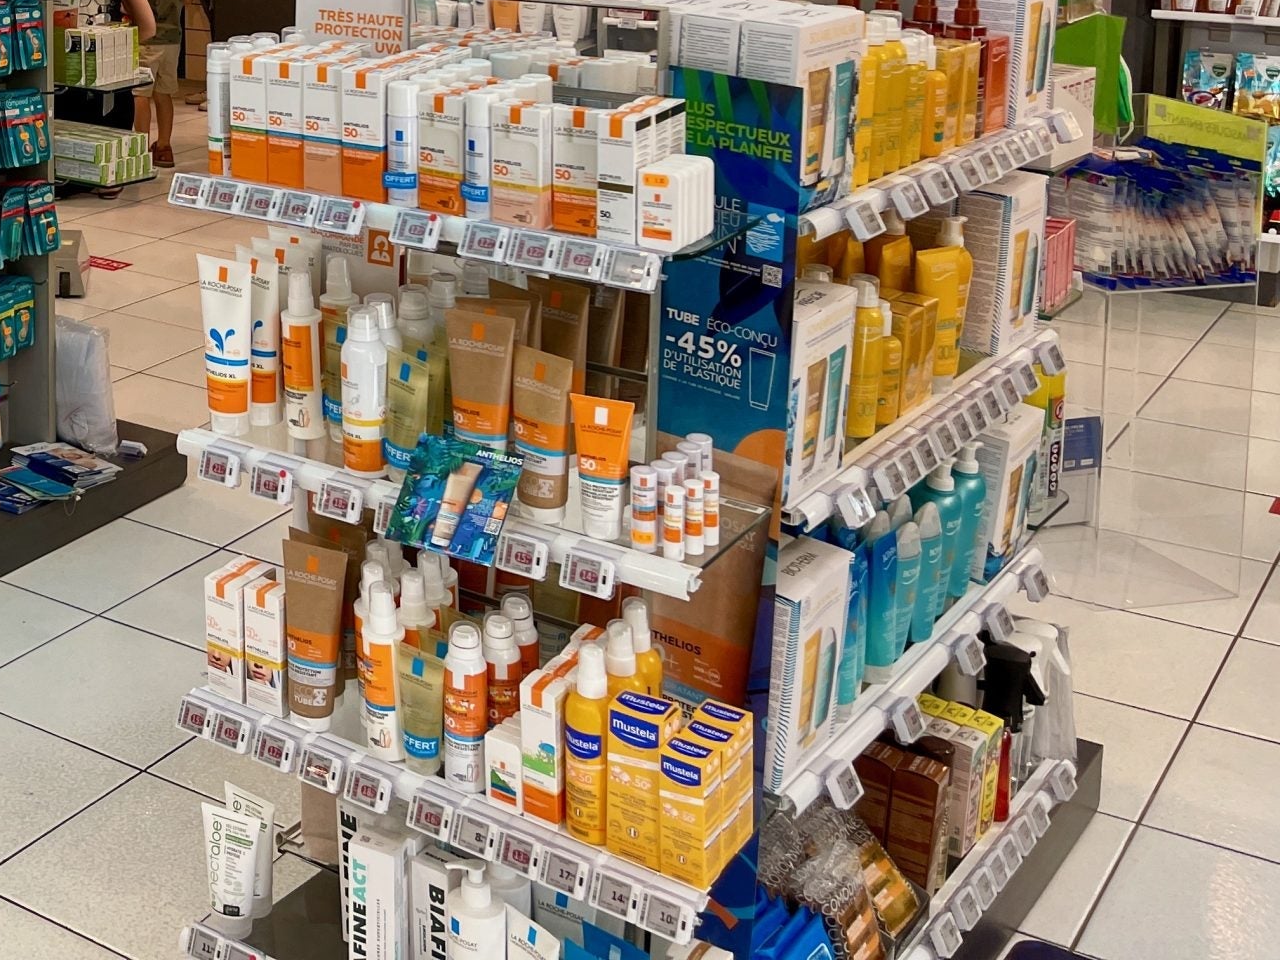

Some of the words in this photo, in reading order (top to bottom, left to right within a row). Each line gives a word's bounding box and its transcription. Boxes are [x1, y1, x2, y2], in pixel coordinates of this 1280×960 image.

[319, 8, 354, 25] TRÈS
[357, 12, 404, 28] HAUTE
[314, 22, 403, 40] PROTECTION
[375, 43, 403, 54] UVA
[686, 117, 791, 148] ESPECTUEUX
[696, 135, 716, 149] LA
[718, 137, 794, 164] PLANÈTE
[384, 174, 415, 184] OFFERT
[666, 307, 700, 327] TUBE
[706, 318, 778, 348] ÉCO-CONÇU
[666, 331, 743, 368] -45%
[663, 358, 677, 371] DE
[683, 364, 741, 390] PLASTIQUE
[664, 348, 742, 380] D'UTILISATION
[476, 448, 524, 467] ANTHELIOS
[781, 552, 818, 578] BIOTHERM
[620, 692, 666, 711] mustela
[612, 718, 656, 742] mustela
[663, 761, 700, 781] mustela
